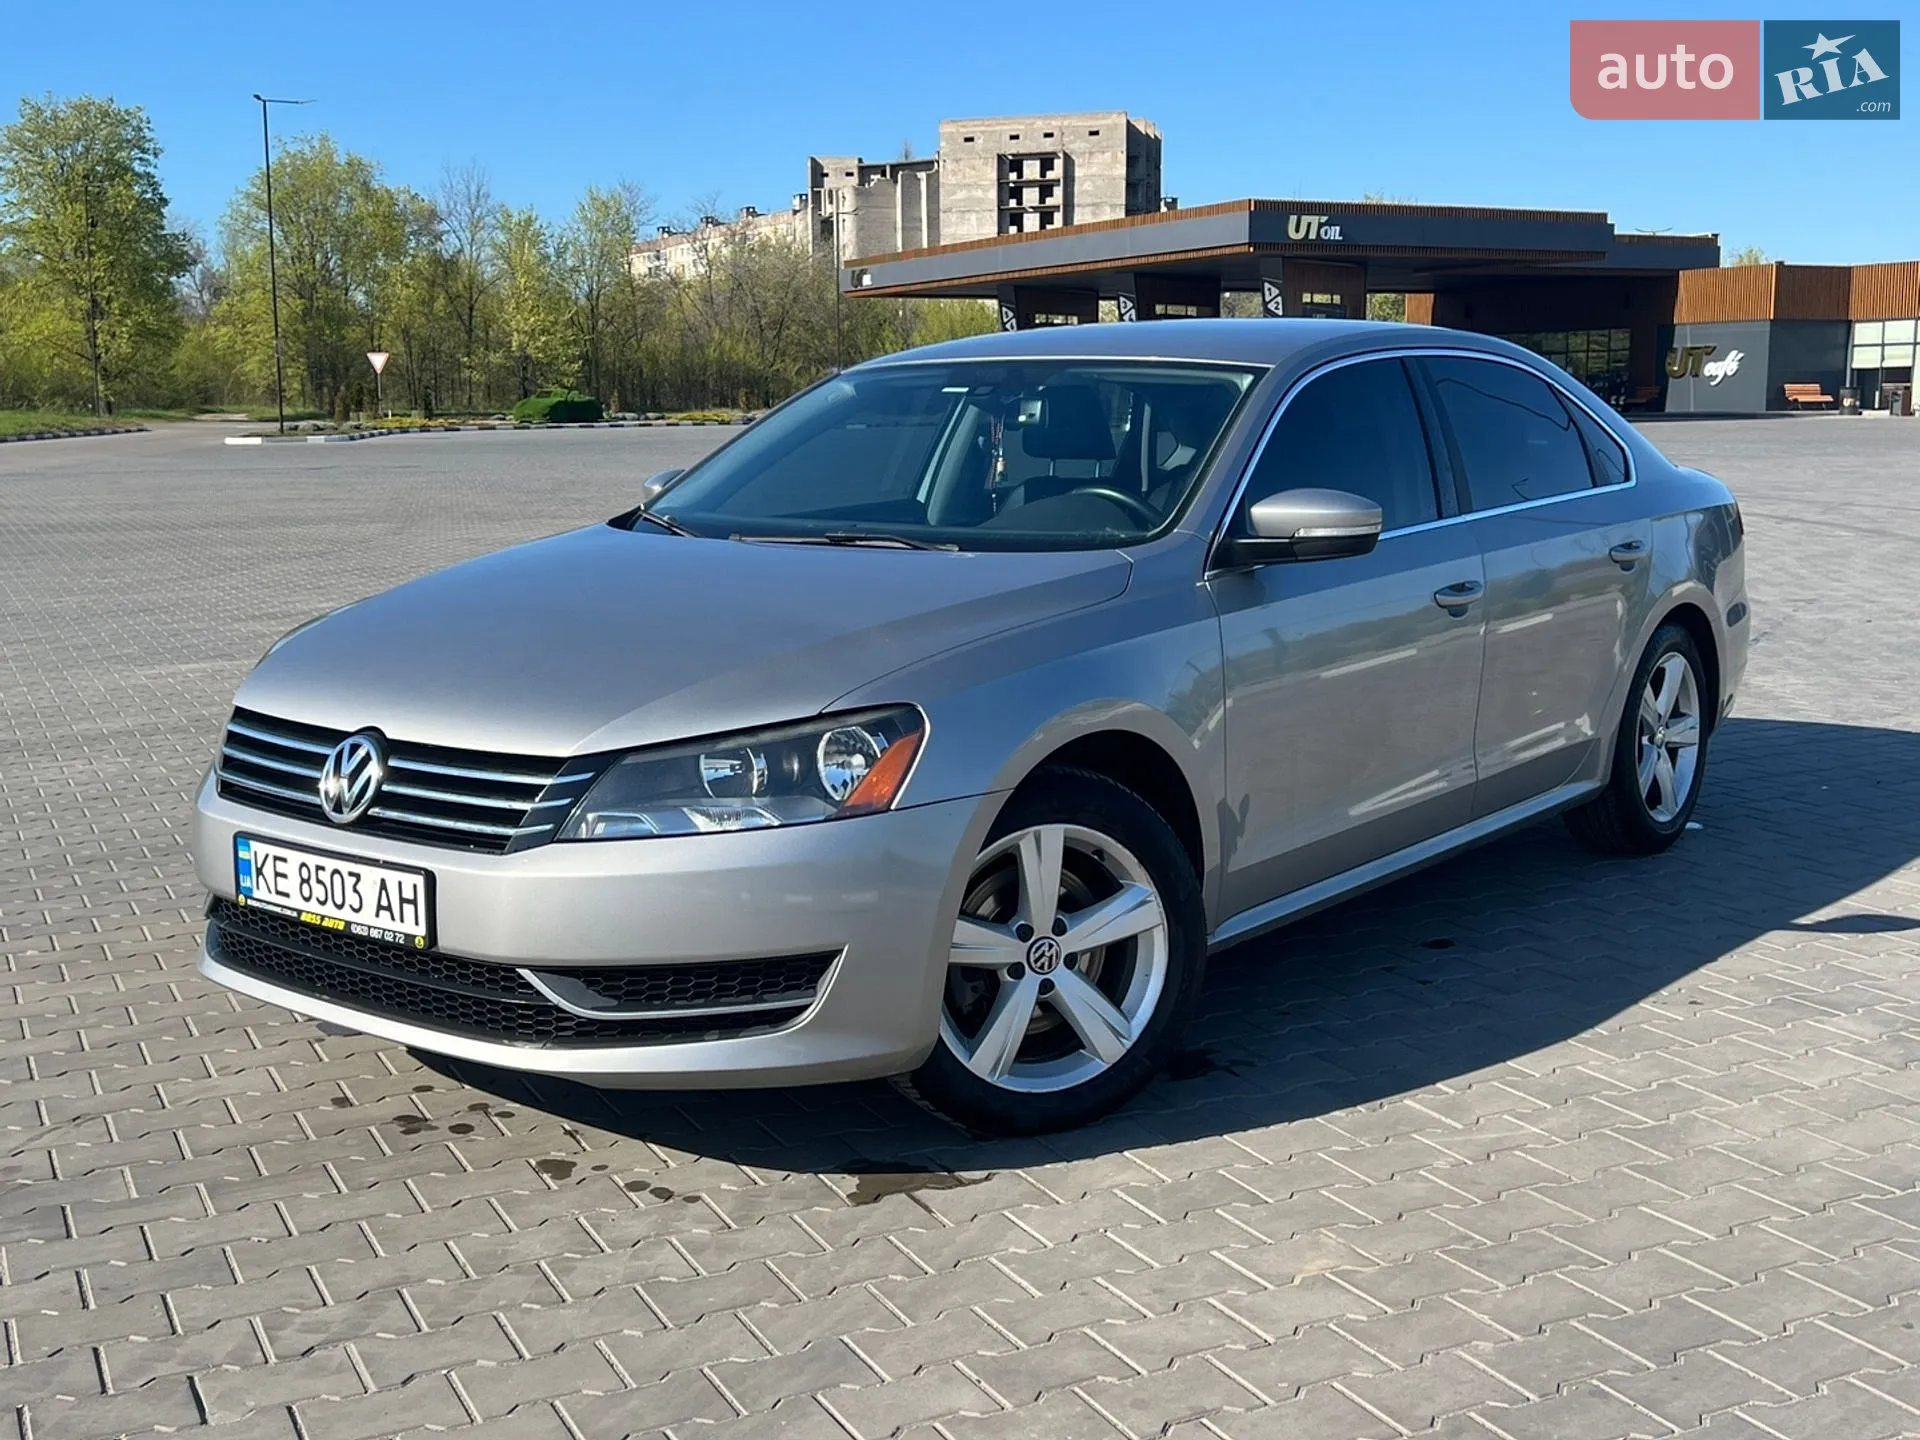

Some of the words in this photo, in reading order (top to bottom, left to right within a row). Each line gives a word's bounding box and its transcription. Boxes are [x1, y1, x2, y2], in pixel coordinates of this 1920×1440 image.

[1287, 214, 1329, 240] UT
[1320, 226, 1343, 240] OIL
[1267, 287, 1272, 297] 1
[1273, 301, 1280, 311] 2
[1665, 345, 1717, 379] UT
[253, 850, 290, 899] KE
[299, 861, 364, 914] 8503
[374, 877, 420, 927] AH
[395, 933, 405, 944] 72
